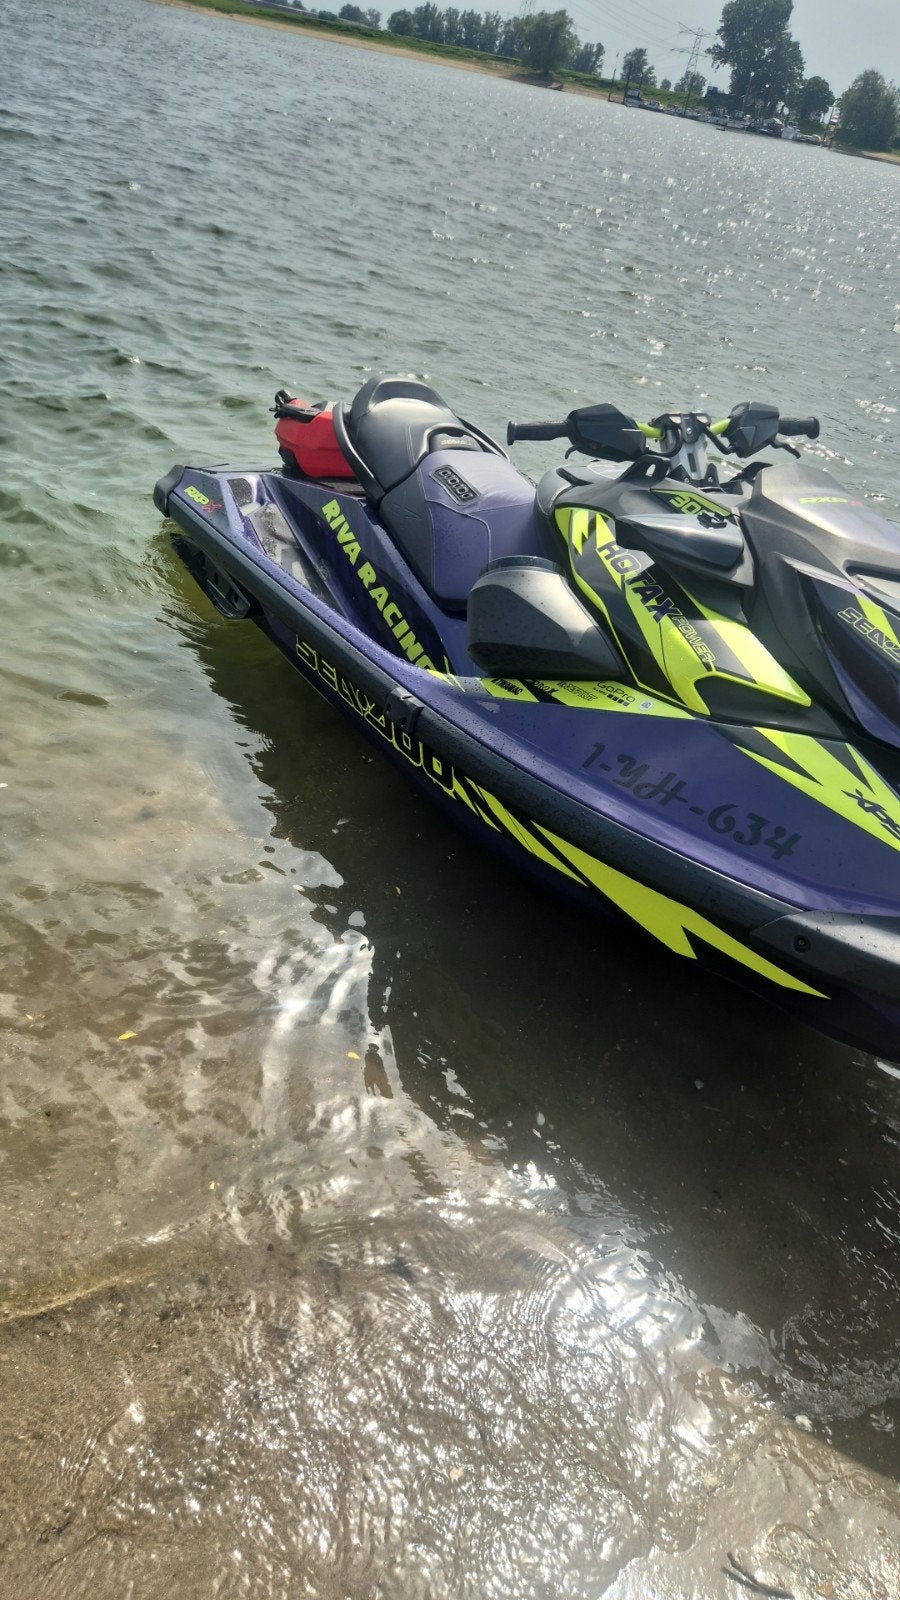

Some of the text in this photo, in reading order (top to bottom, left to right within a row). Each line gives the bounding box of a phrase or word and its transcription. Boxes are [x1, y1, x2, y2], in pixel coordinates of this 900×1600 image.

[322, 499, 361, 566] RIVA
[595, 540, 716, 662] ROTAX POWER
[596, 681, 636, 703] GoPro
